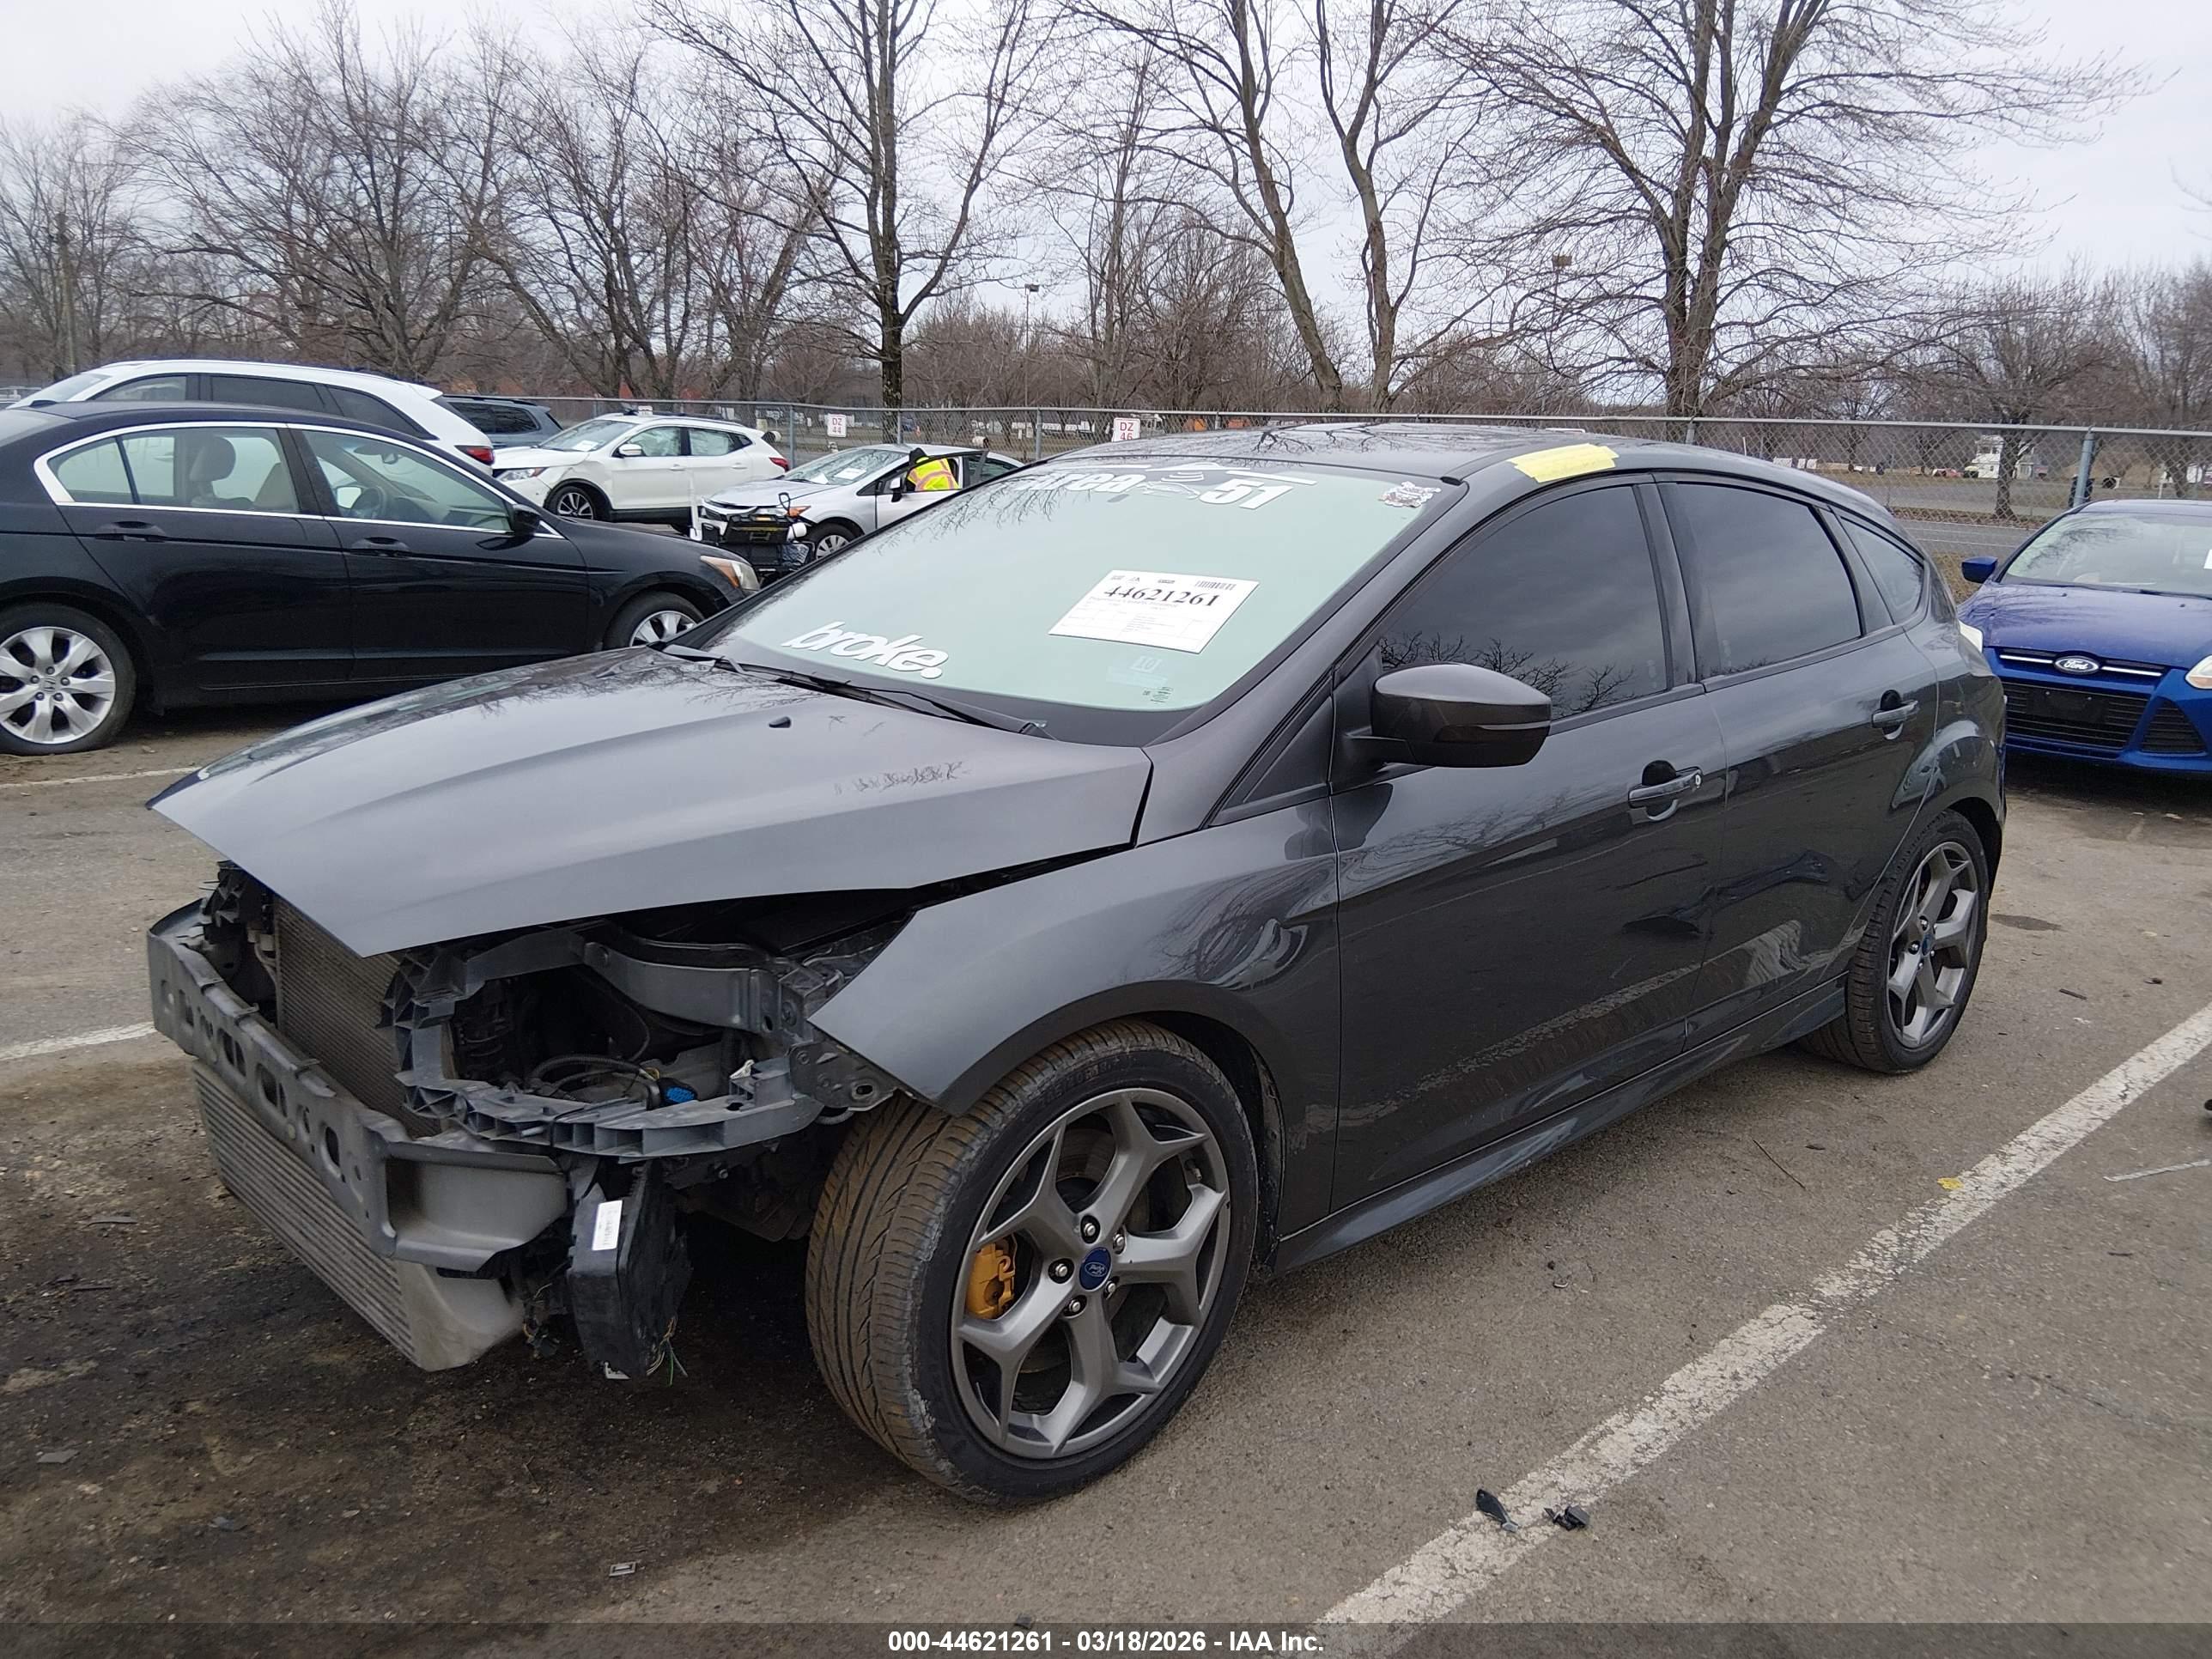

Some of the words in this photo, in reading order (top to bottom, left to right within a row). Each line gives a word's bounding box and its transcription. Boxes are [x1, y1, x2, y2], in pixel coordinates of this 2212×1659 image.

[832, 417, 842, 426] DZ
[1120, 422, 1134, 432] DZ
[1120, 432, 1133, 441] 46
[1200, 478, 1294, 509] 51
[1103, 586, 1220, 606] 44621261
